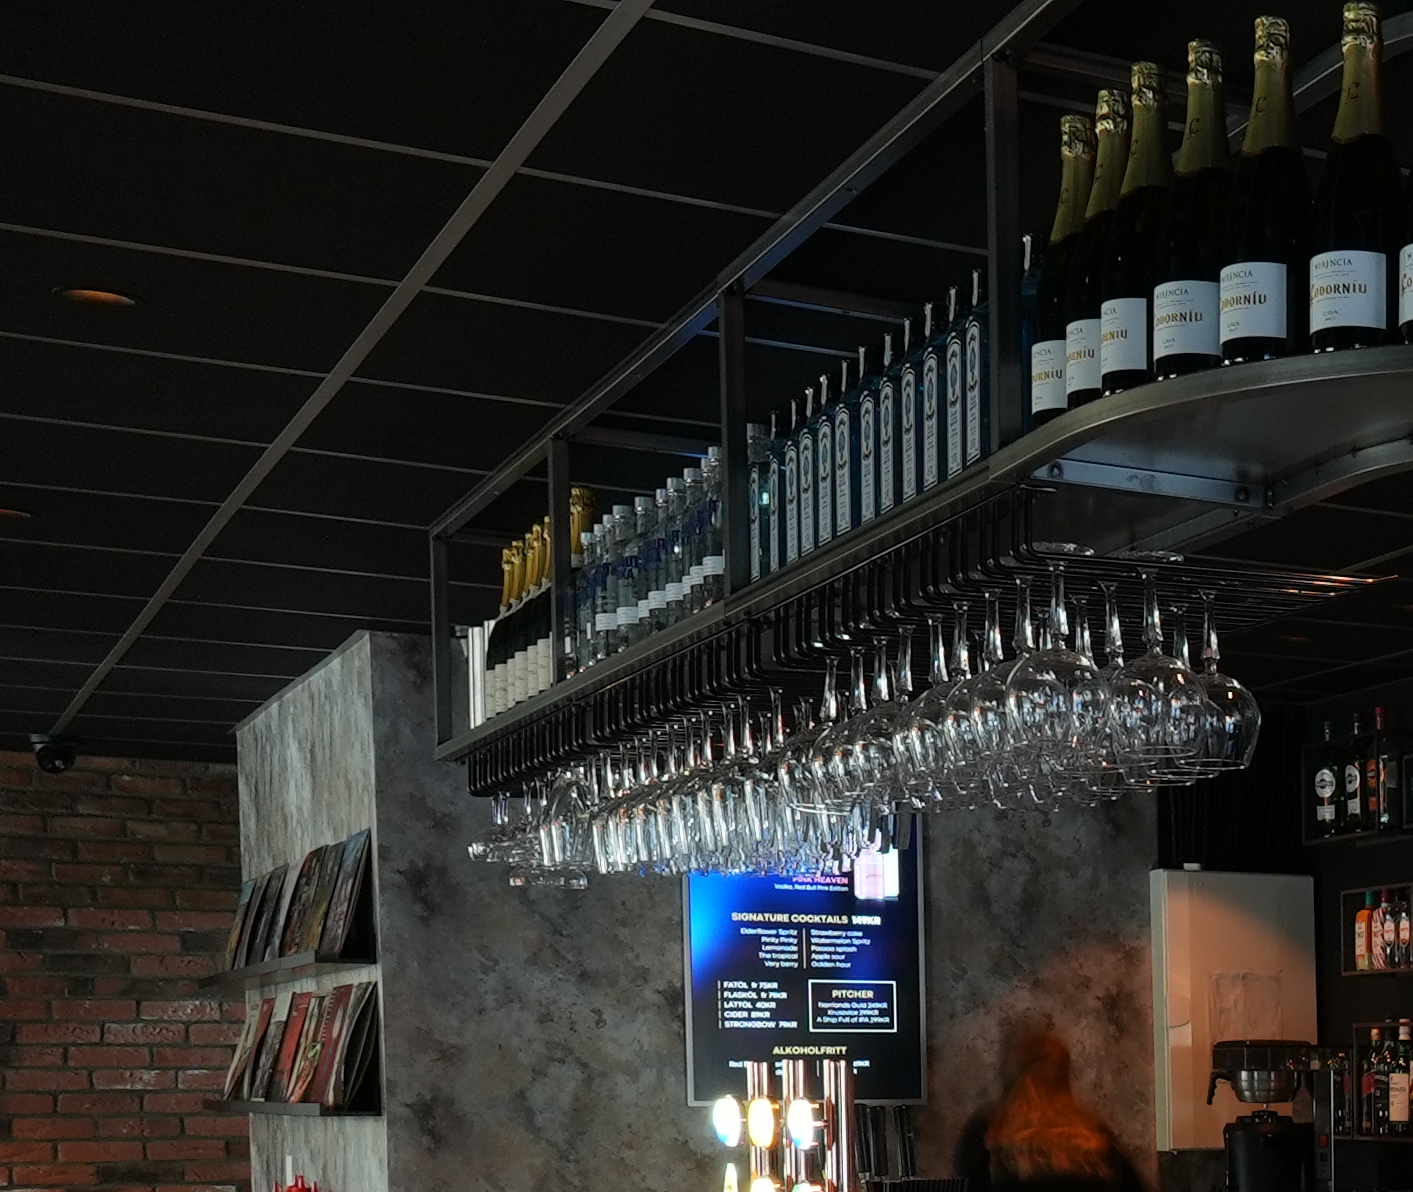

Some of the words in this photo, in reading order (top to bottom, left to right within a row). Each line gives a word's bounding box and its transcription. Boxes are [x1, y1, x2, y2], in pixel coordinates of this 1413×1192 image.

[1315, 258, 1353, 271] HERENCIA
[731, 912, 789, 923] SIGNATURE
[790, 913, 848, 924] COCKTAILS
[832, 990, 874, 998] PITCHER
[772, 1046, 847, 1055] ALKOHOLFRITT
